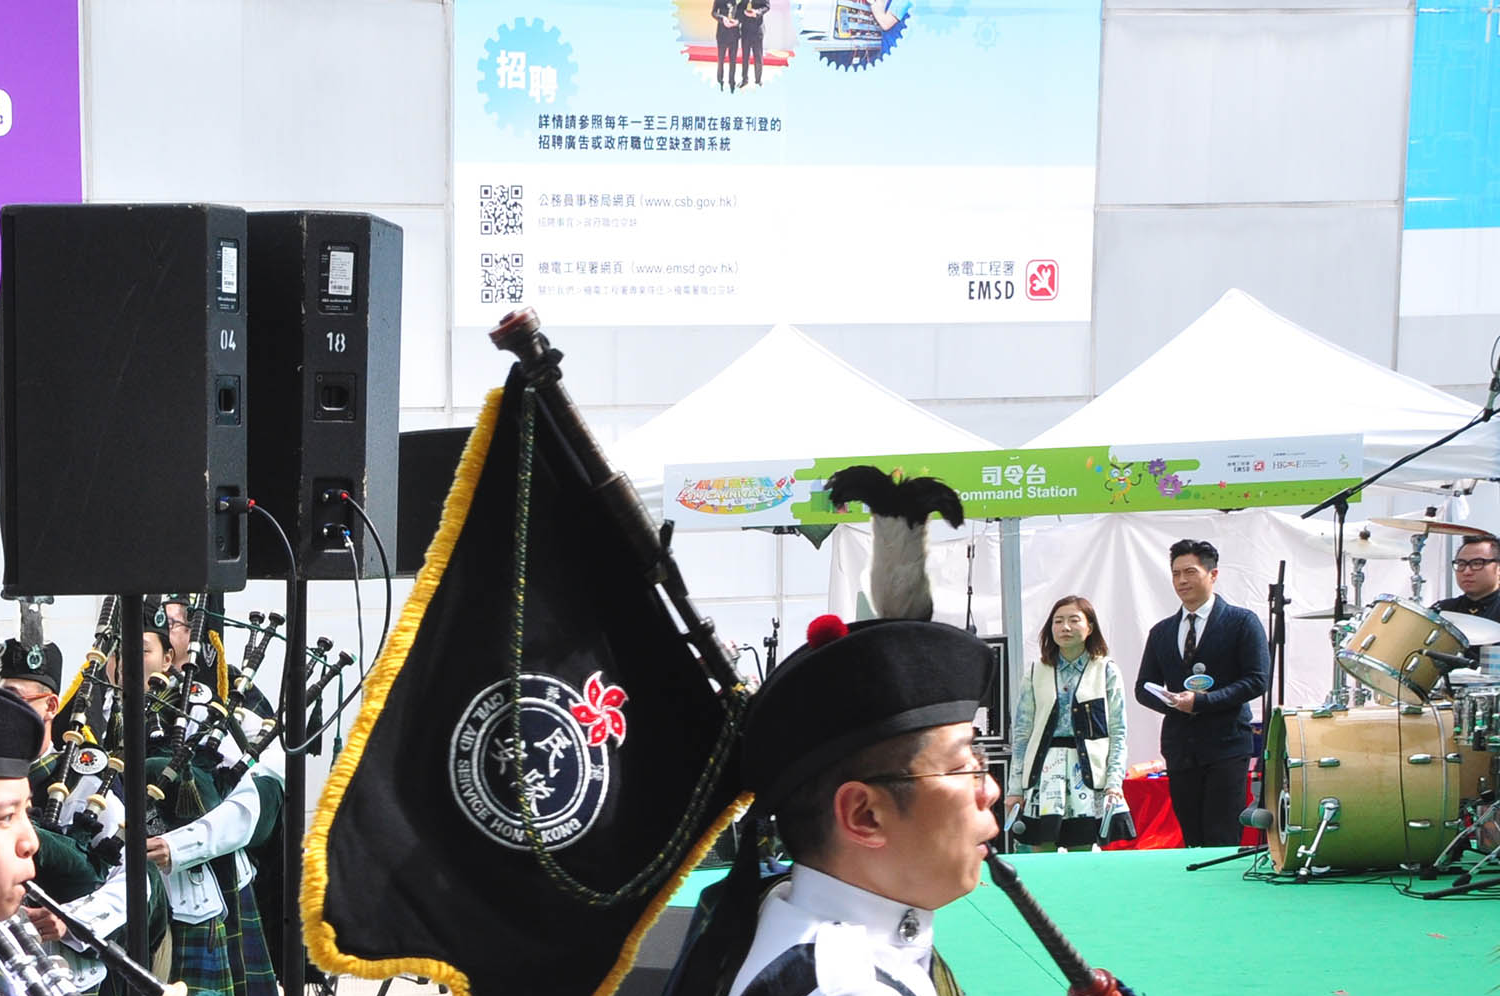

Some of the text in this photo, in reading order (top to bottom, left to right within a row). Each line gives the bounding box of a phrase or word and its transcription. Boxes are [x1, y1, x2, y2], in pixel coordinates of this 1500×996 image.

[496, 49, 558, 103] 招聘
[948, 260, 1015, 276] 機電工程署
[968, 280, 1015, 300] EMSD
[220, 329, 237, 351] 04
[326, 332, 346, 353] 18
[982, 464, 1046, 486] 司令台
[1027, 486, 1077, 499] Station
[457, 693, 582, 844] CIVIL AID SERVICE HON KONG
